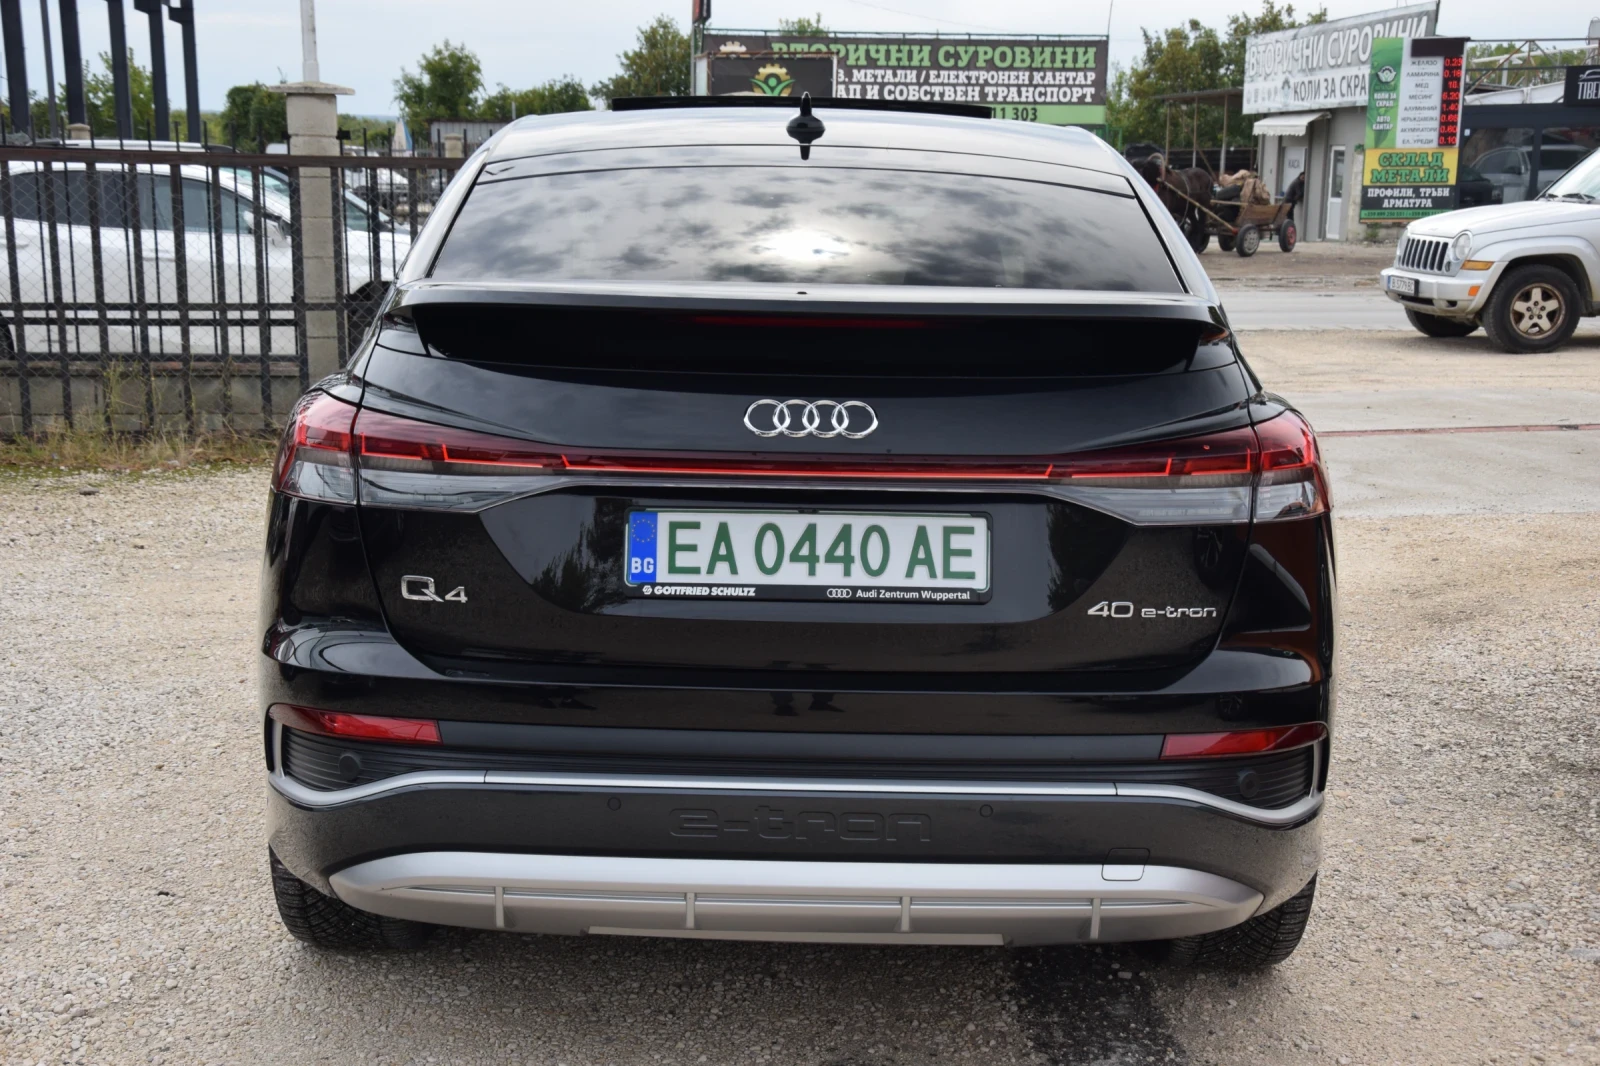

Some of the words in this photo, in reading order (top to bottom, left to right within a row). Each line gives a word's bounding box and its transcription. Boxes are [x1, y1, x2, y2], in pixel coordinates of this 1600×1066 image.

[938, 46, 1096, 69] СУРОВИНИ
[1250, 34, 1324, 77] ВТОРИЧНИ
[852, 69, 917, 83] МЕТАЛИ
[929, 70, 1029, 85] ЕЛЕКТРОНЕН
[1033, 71, 1096, 85] КАНТАР
[866, 85, 880, 99] И
[884, 85, 980, 102] СОБСТВЕН
[984, 86, 1095, 102] ТРАНСПОРТ
[1293, 80, 1321, 100] КОЛИ
[1324, 77, 1336, 99] ЗА
[1340, 74, 1366, 97] СКРА
[1012, 107, 1037, 121] 303
[1378, 152, 1444, 168] СКЛАД
[1370, 168, 1449, 183] МЕТАЛИ
[1368, 188, 1415, 198] ПРОФИЛИ,
[1420, 188, 1450, 197] ТРЪБИ
[1382, 199, 1432, 208] АРМАТУРА
[668, 521, 739, 575] EA
[754, 523, 890, 578] 0440
[905, 525, 976, 579] AE
[631, 558, 654, 574] BG
[401, 575, 468, 603] Q4
[654, 586, 710, 595] GOTTFRIED
[711, 587, 756, 596] SCHULTZ
[856, 589, 877, 598] Audi
[879, 590, 919, 598] Zentrum
[921, 590, 970, 601] Wuppertal
[1088, 601, 1134, 618] 40
[1141, 606, 1216, 618] e-tron
[669, 805, 932, 842] e-tron
